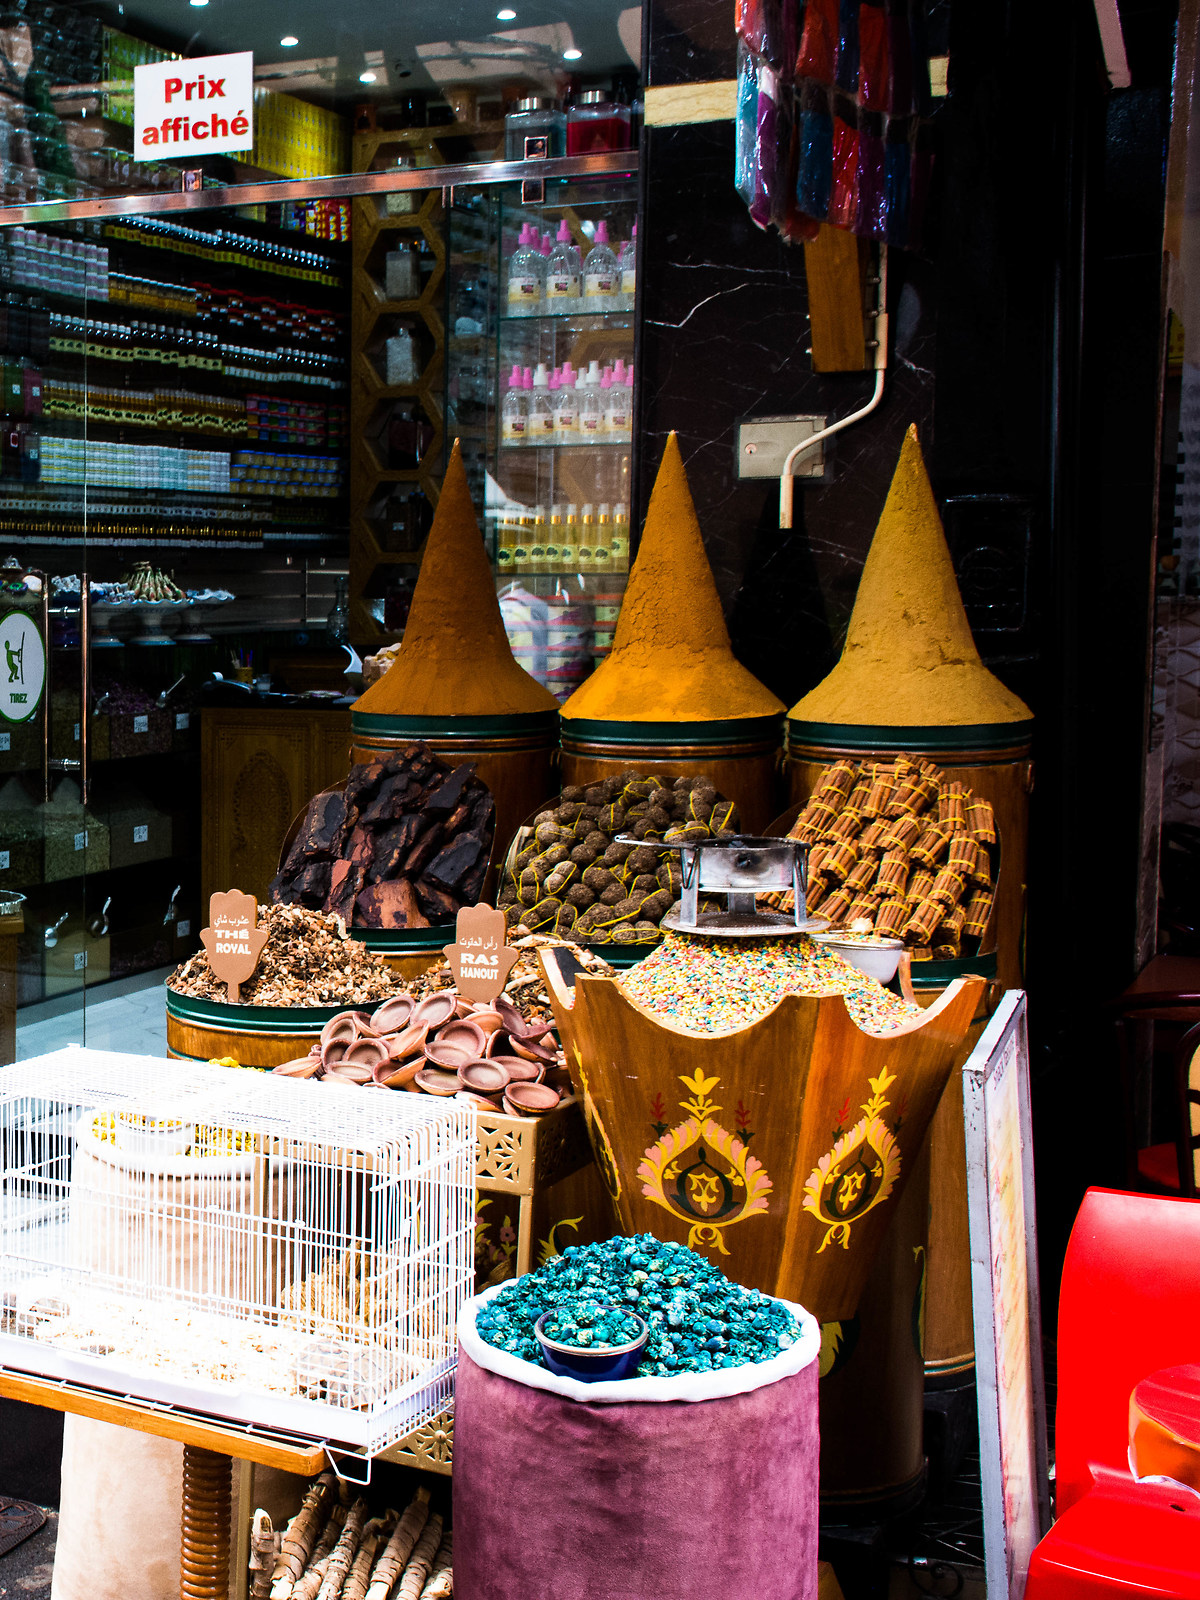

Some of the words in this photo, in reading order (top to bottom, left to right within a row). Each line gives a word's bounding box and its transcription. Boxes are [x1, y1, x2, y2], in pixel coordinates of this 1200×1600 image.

[164, 74, 226, 104] Prix
[142, 109, 250, 146] affiché
[9, 693, 28, 704] TIREZ
[214, 929, 250, 940] THÉ
[215, 943, 252, 955] ROYAL
[460, 953, 499, 966] RAS
[460, 966, 499, 980] HANOUT
